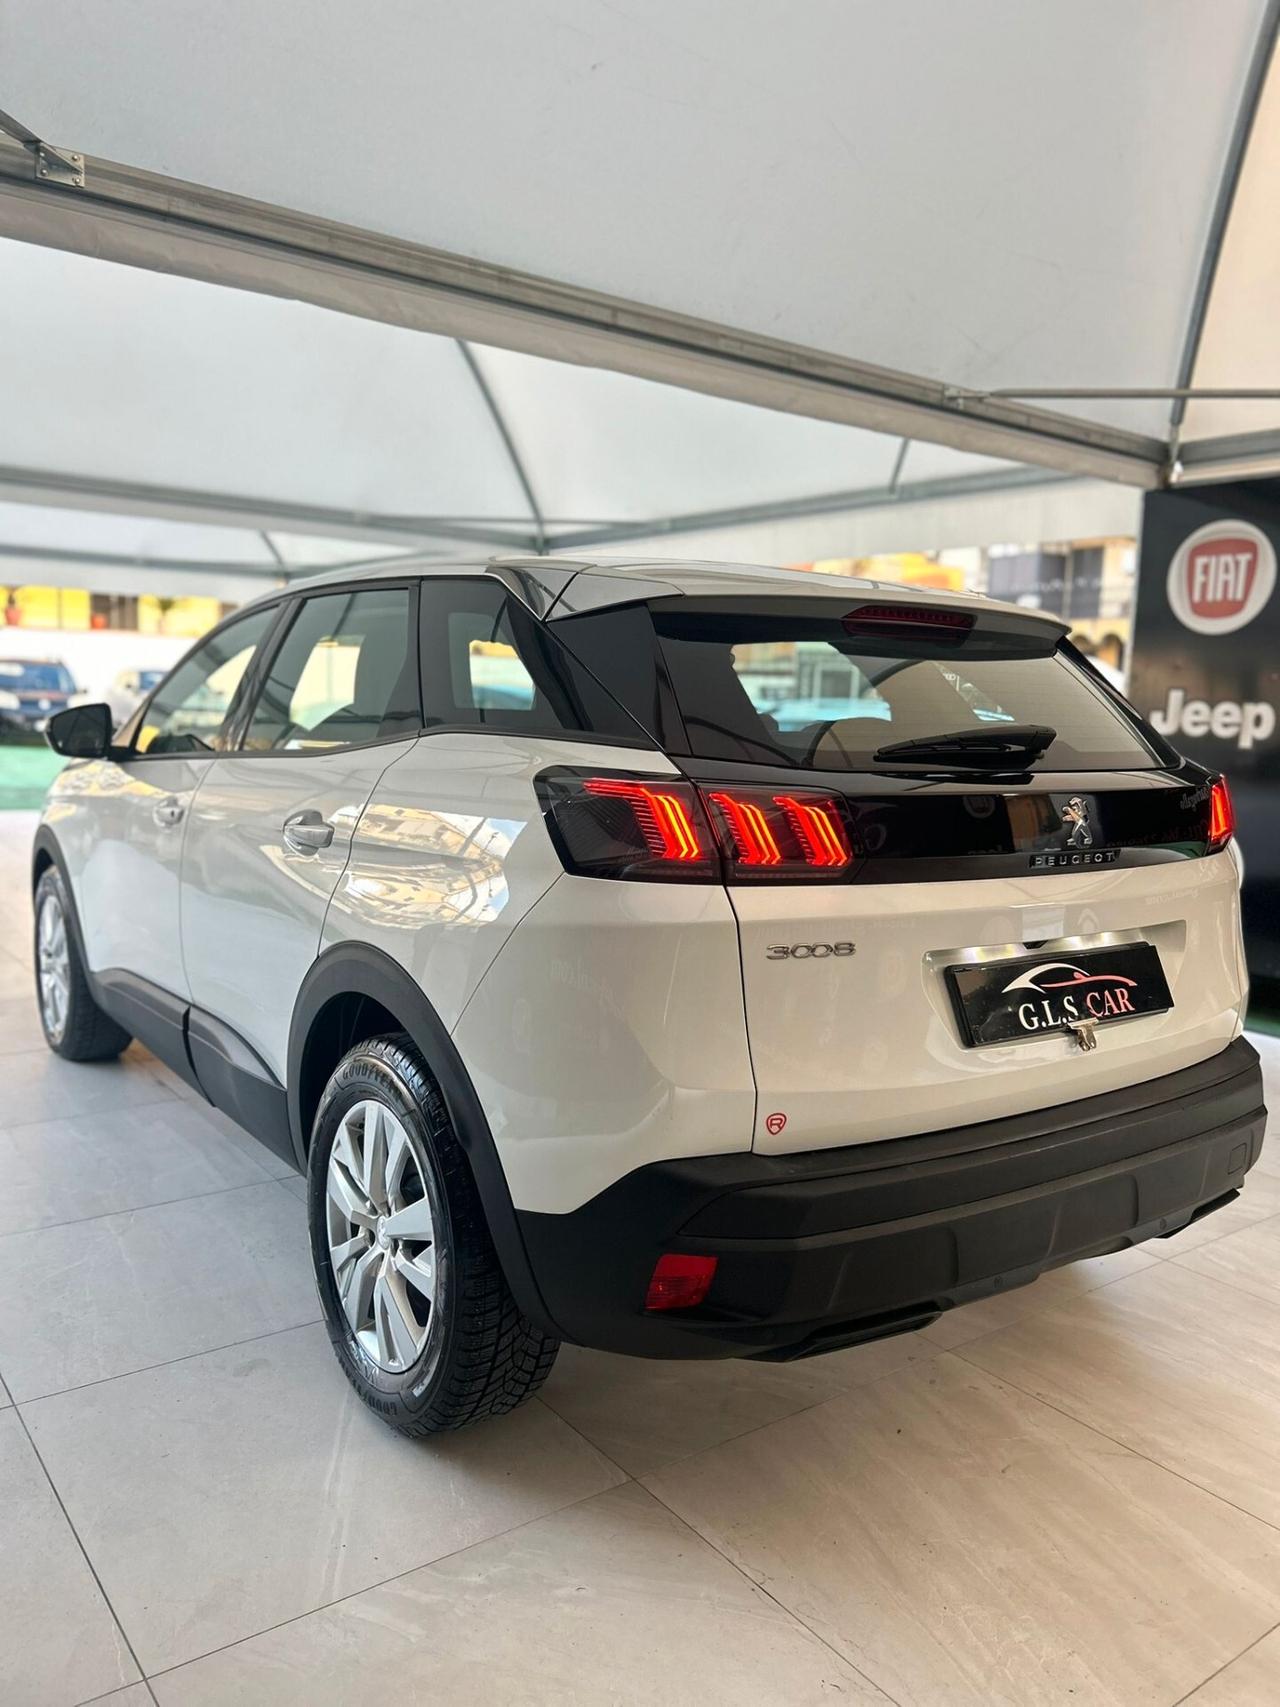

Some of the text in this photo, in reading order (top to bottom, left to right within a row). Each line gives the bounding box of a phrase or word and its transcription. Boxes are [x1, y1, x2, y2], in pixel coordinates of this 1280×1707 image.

[1193, 553, 1252, 603] FIAT
[1150, 689, 1276, 749] Jeep
[1034, 852, 1114, 867] PEUGEOT
[766, 942, 857, 960] 3008
[1086, 988, 1135, 1018] CAR
